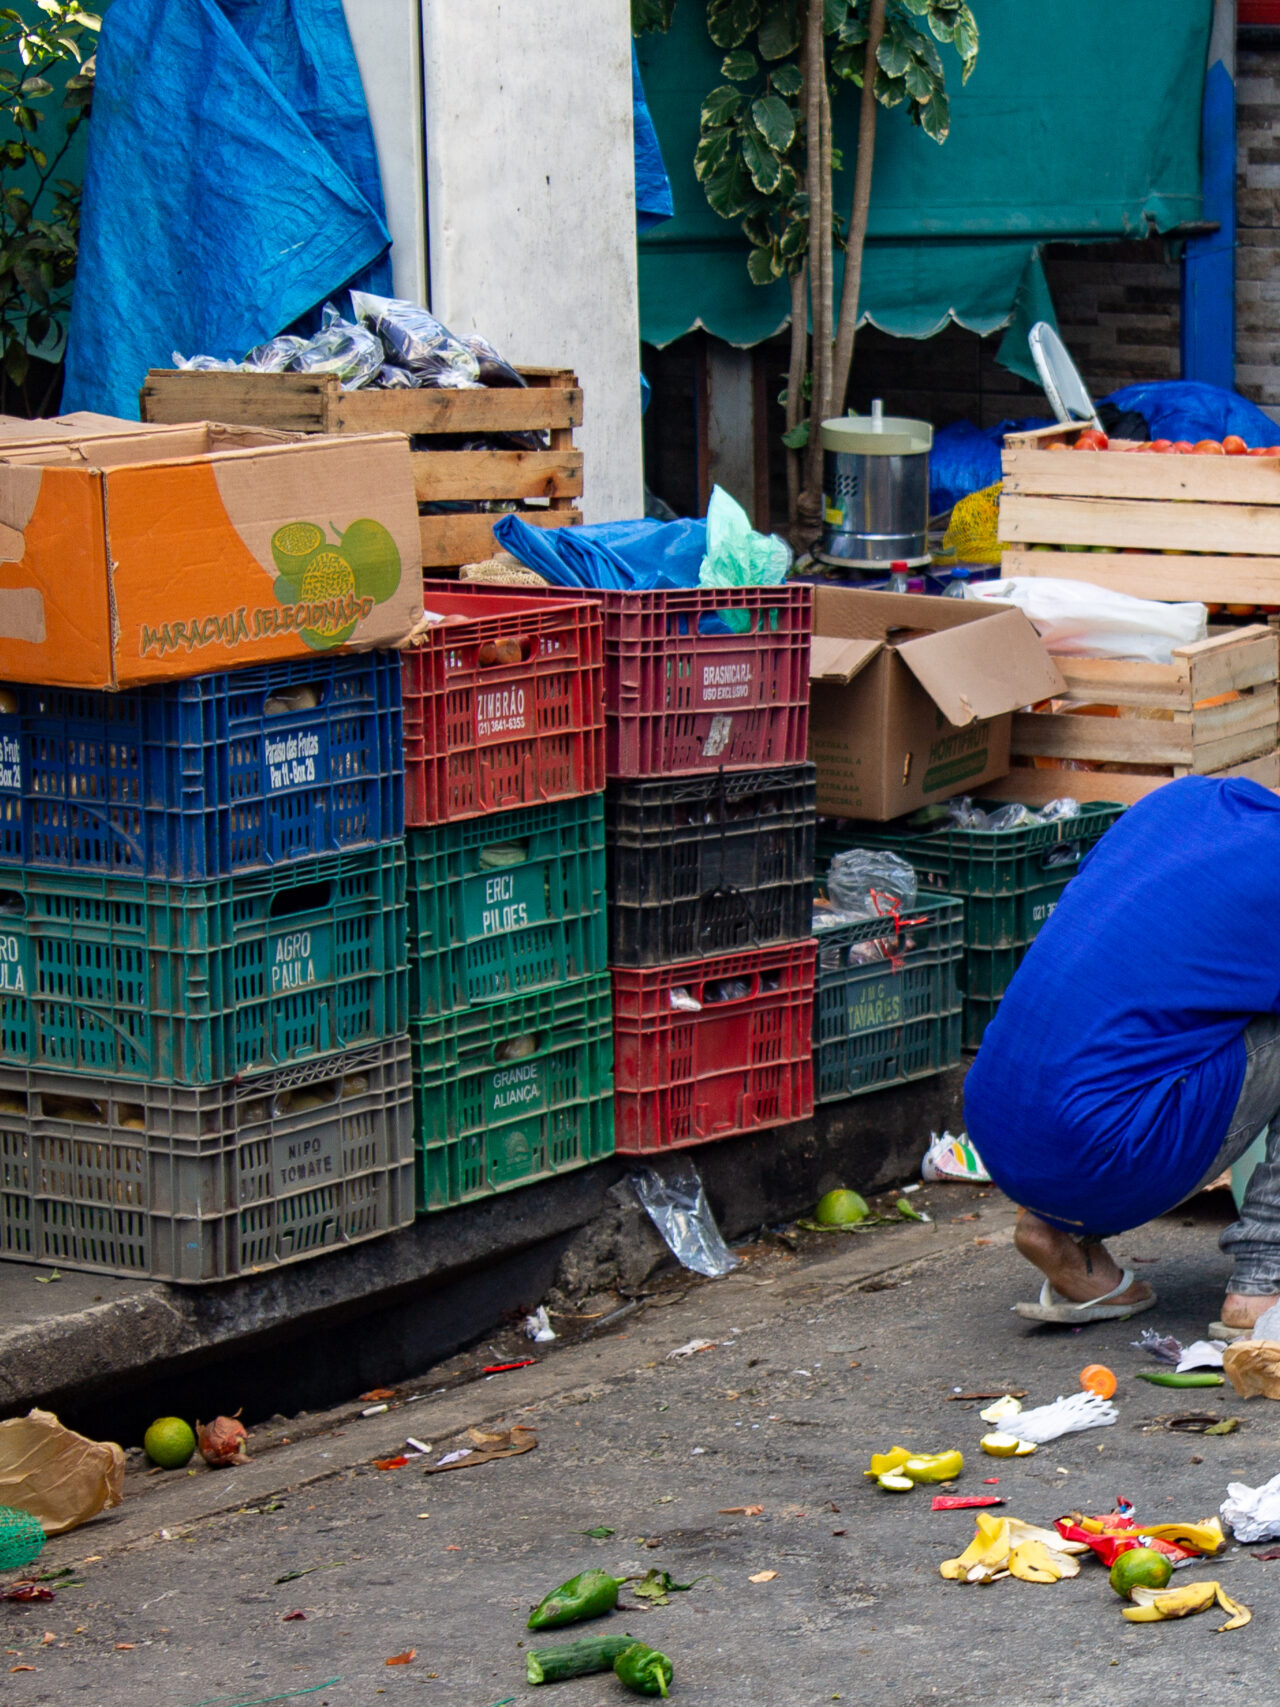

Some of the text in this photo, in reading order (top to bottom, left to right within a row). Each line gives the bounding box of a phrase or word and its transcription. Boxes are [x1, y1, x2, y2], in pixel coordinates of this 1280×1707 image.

[140, 591, 375, 658] MARACUJÁ SELECIONADO
[703, 664, 740, 686] BRASNICA
[702, 684, 749, 701] USO EXCLUSIVO
[286, 734, 298, 761] das
[297, 731, 319, 758] Frutas
[270, 765, 282, 788] Pav
[292, 760, 306, 784] Box
[486, 875, 514, 904] ERCI
[276, 931, 311, 964] AGRO
[271, 958, 315, 993] PAULA
[848, 996, 900, 1031] TAVARES
[493, 1063, 538, 1088] GRANDE
[288, 1137, 321, 1160] NIPO
[281, 1155, 332, 1184] TOMATE
